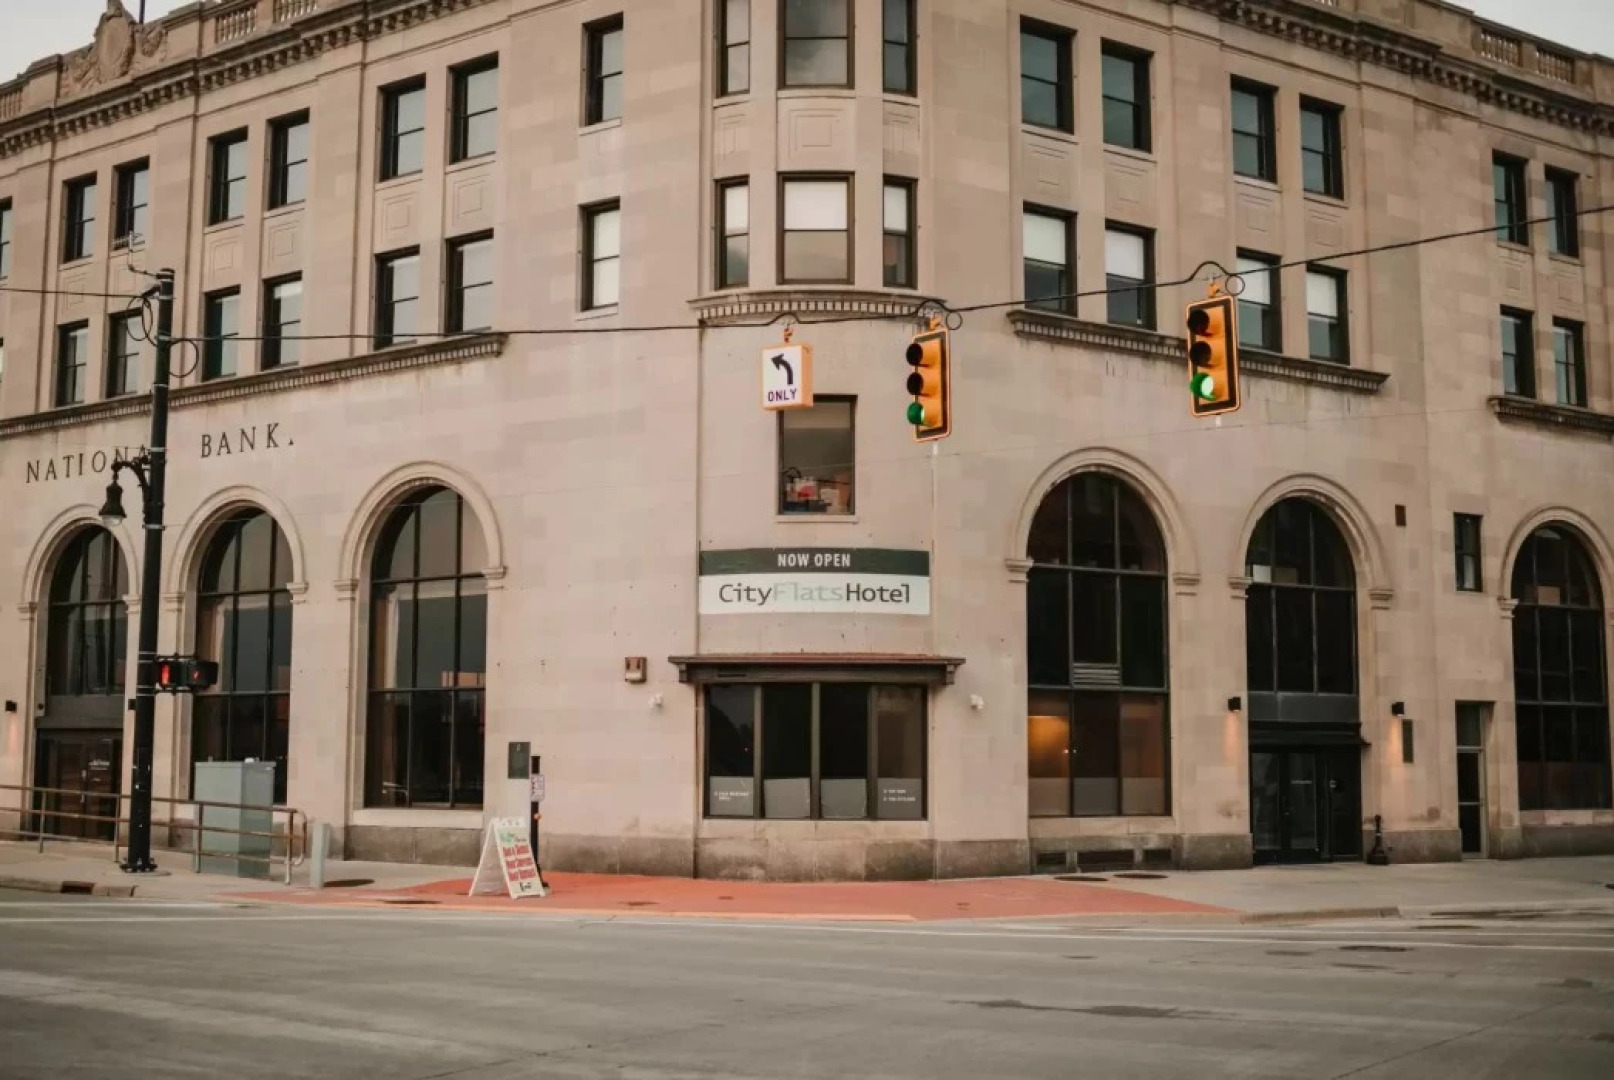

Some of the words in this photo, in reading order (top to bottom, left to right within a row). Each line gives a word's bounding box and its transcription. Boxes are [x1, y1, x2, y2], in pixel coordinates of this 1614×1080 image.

[767, 388, 797, 402] ONLY
[26, 444, 167, 484] NATIONA
[201, 422, 295, 458] BANK.
[777, 553, 810, 567] NOW
[814, 553, 851, 567] OPEN
[718, 581, 911, 606] CityFlatsHotel
